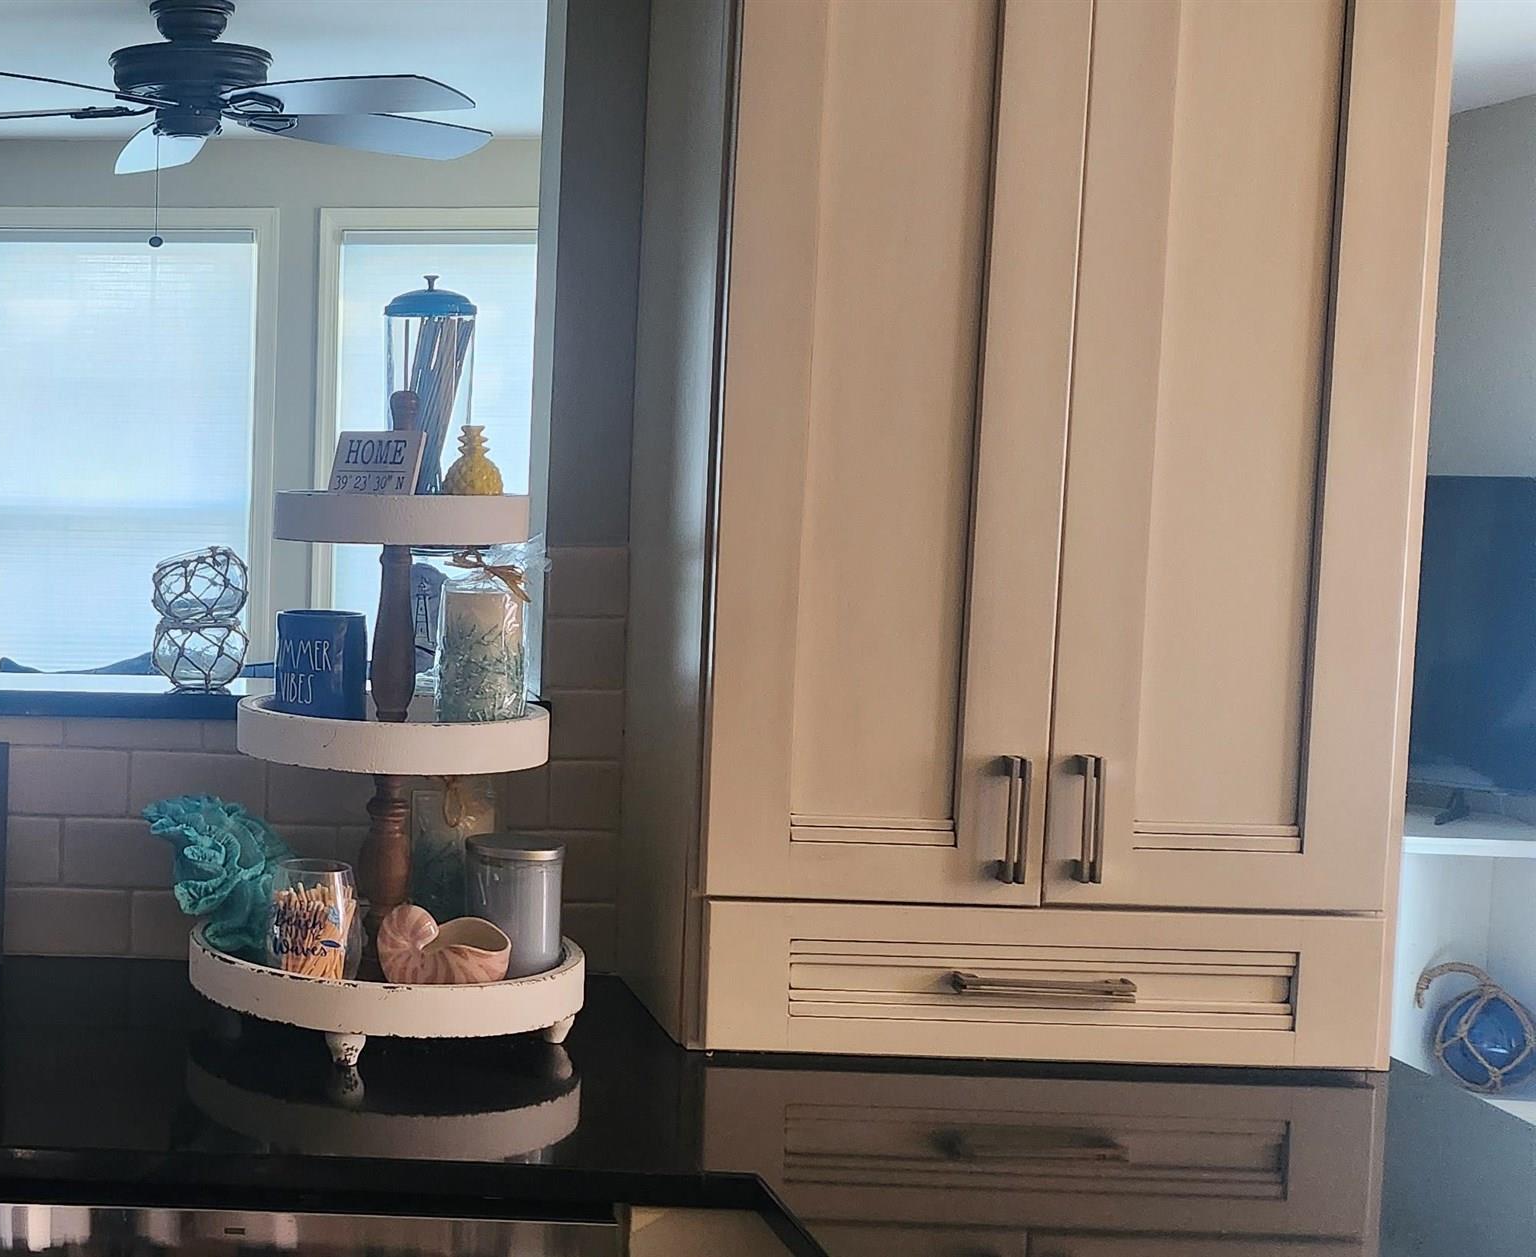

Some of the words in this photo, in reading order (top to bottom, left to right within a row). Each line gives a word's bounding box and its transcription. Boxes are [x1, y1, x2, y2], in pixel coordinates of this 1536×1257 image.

[344, 439, 407, 465] HOME
[395, 476, 405, 490] N
[280, 671, 315, 704] VIBES
